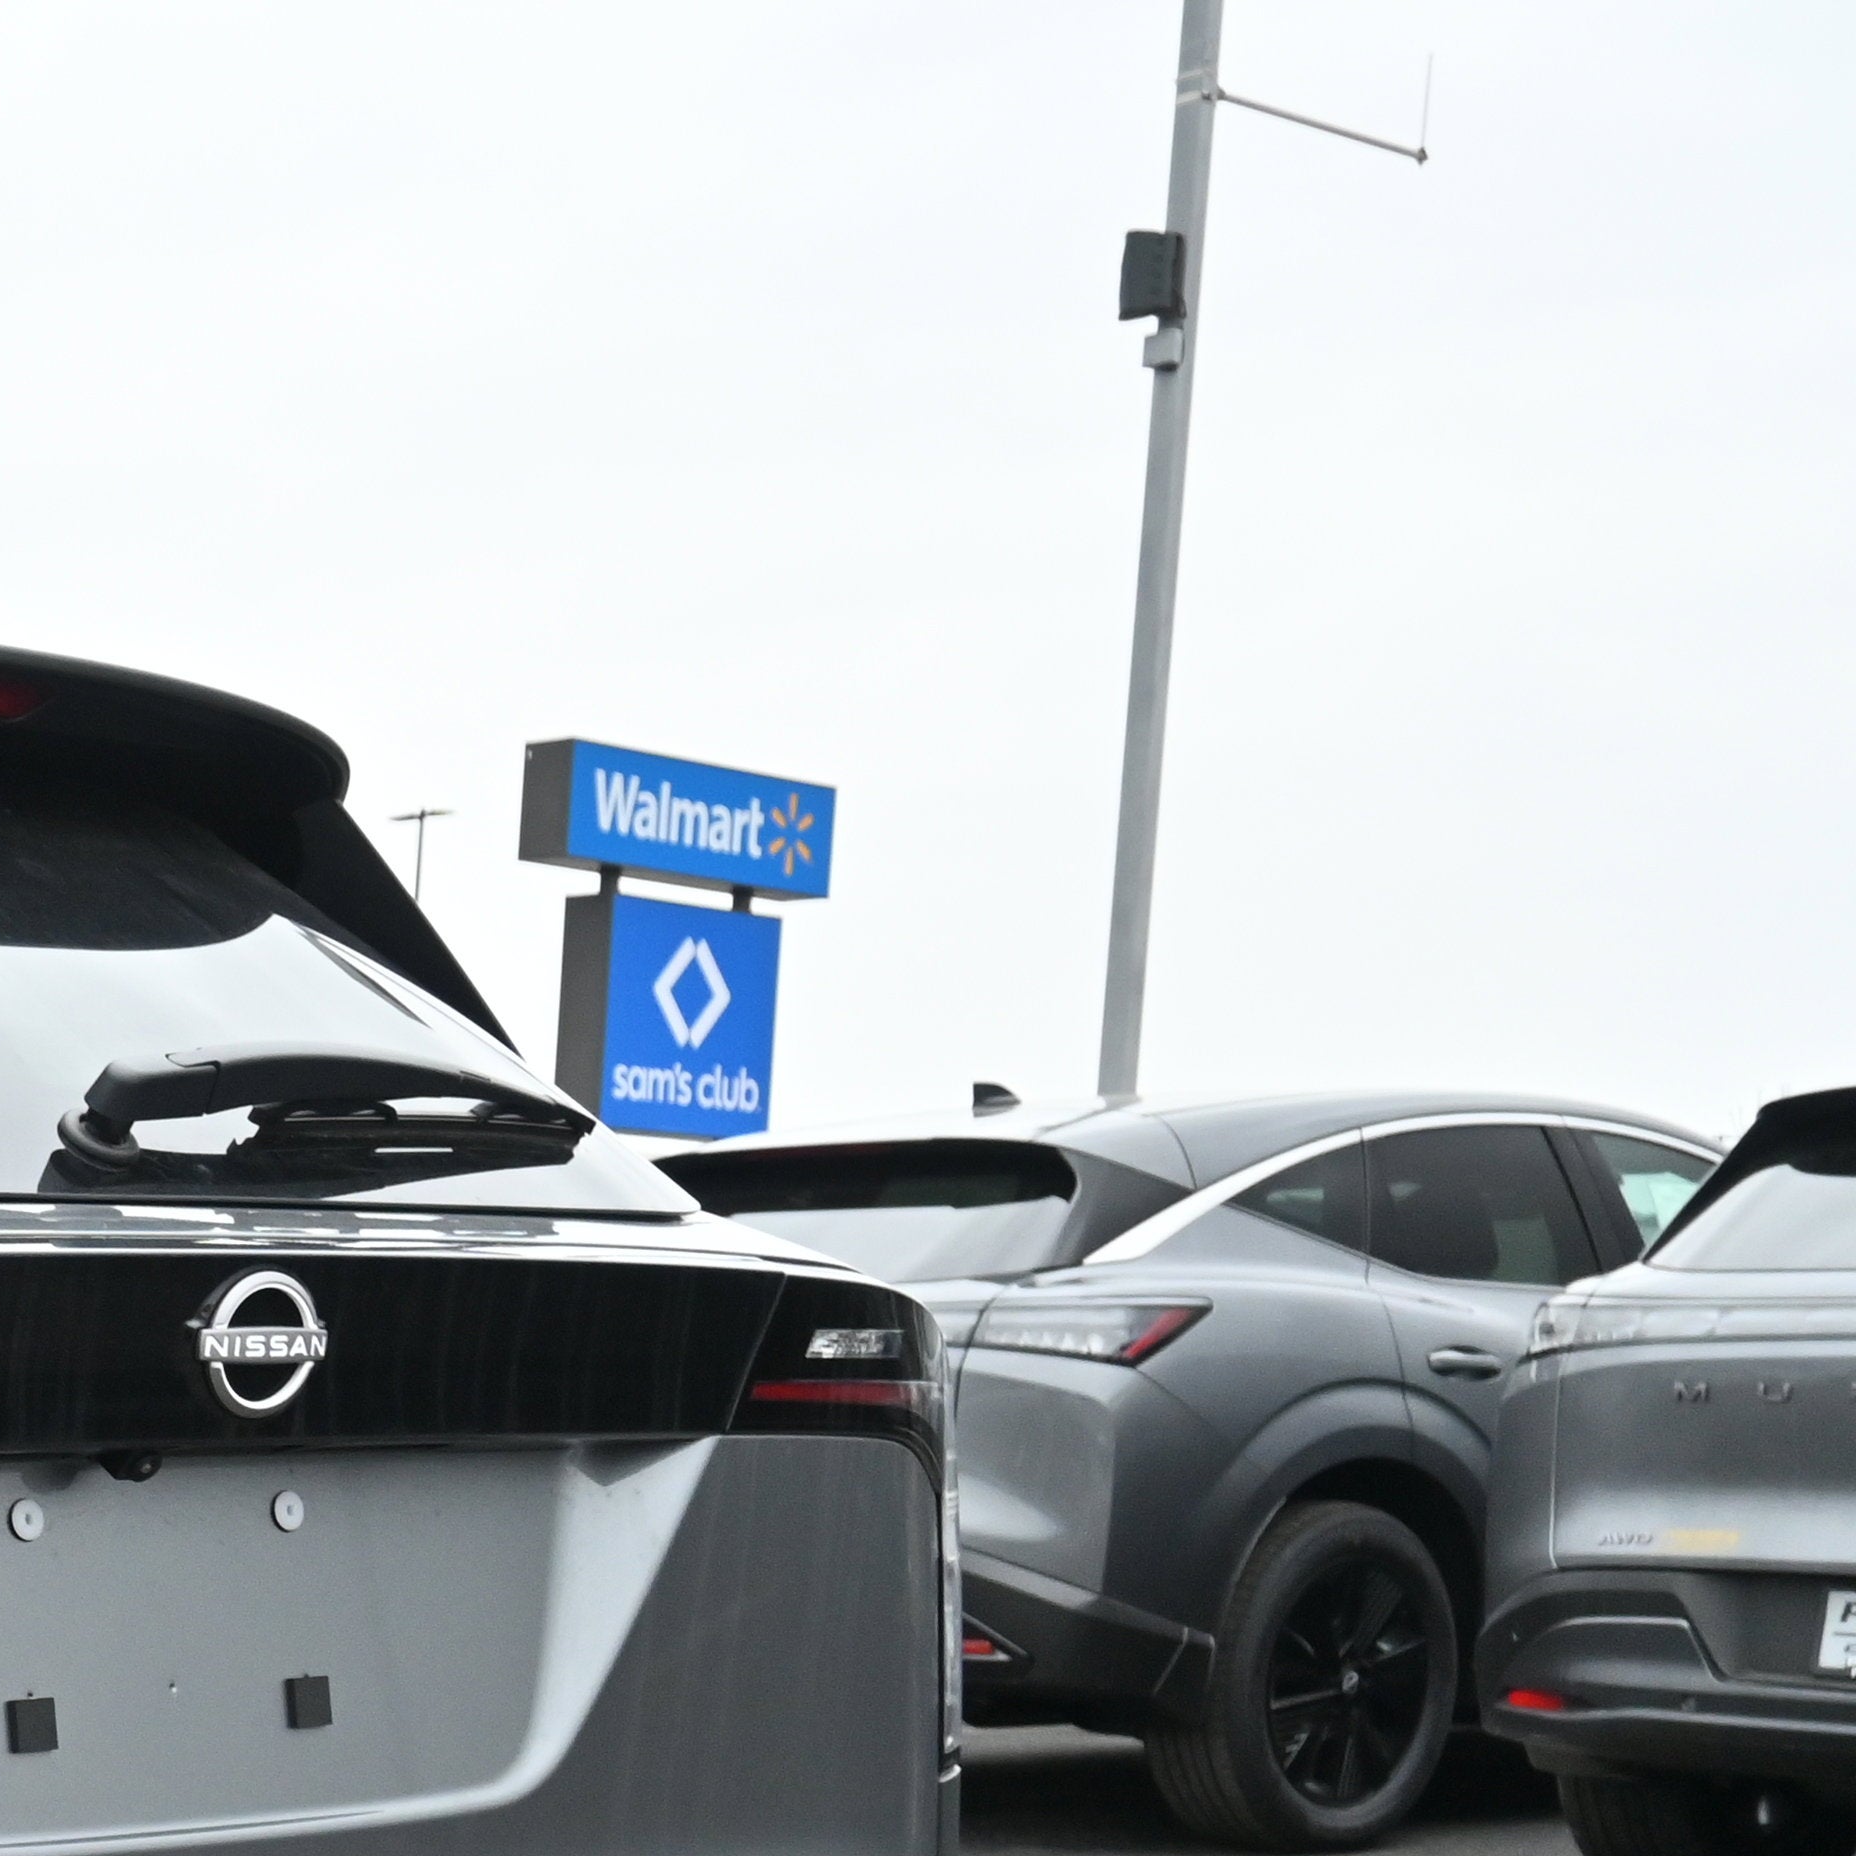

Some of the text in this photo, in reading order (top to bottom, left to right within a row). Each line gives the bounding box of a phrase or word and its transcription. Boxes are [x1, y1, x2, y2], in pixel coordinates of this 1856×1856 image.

[594, 768, 764, 859] Walmart
[613, 1062, 760, 1113] sam's club
[203, 1334, 328, 1358] NISSAN
